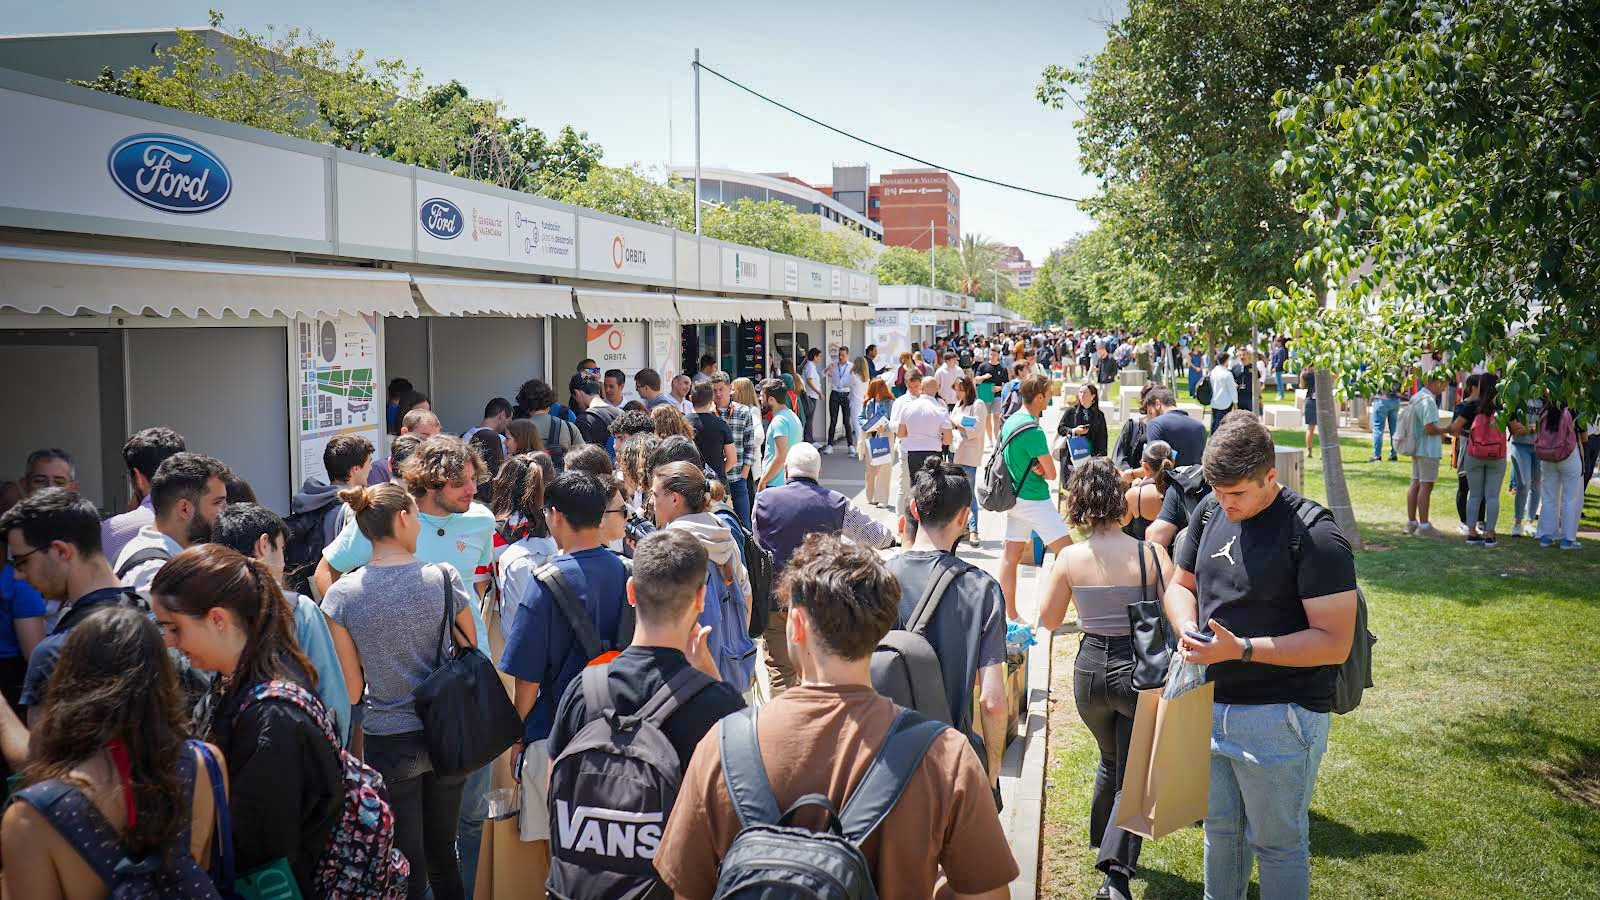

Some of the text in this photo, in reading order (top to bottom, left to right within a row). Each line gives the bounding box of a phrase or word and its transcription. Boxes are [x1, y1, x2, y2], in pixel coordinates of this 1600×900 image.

[136, 144, 209, 202] Ford
[428, 203, 457, 233] Ford
[479, 227, 502, 237] VALENCIANA
[603, 353, 627, 361] ORBITA
[556, 799, 663, 860] VANS
